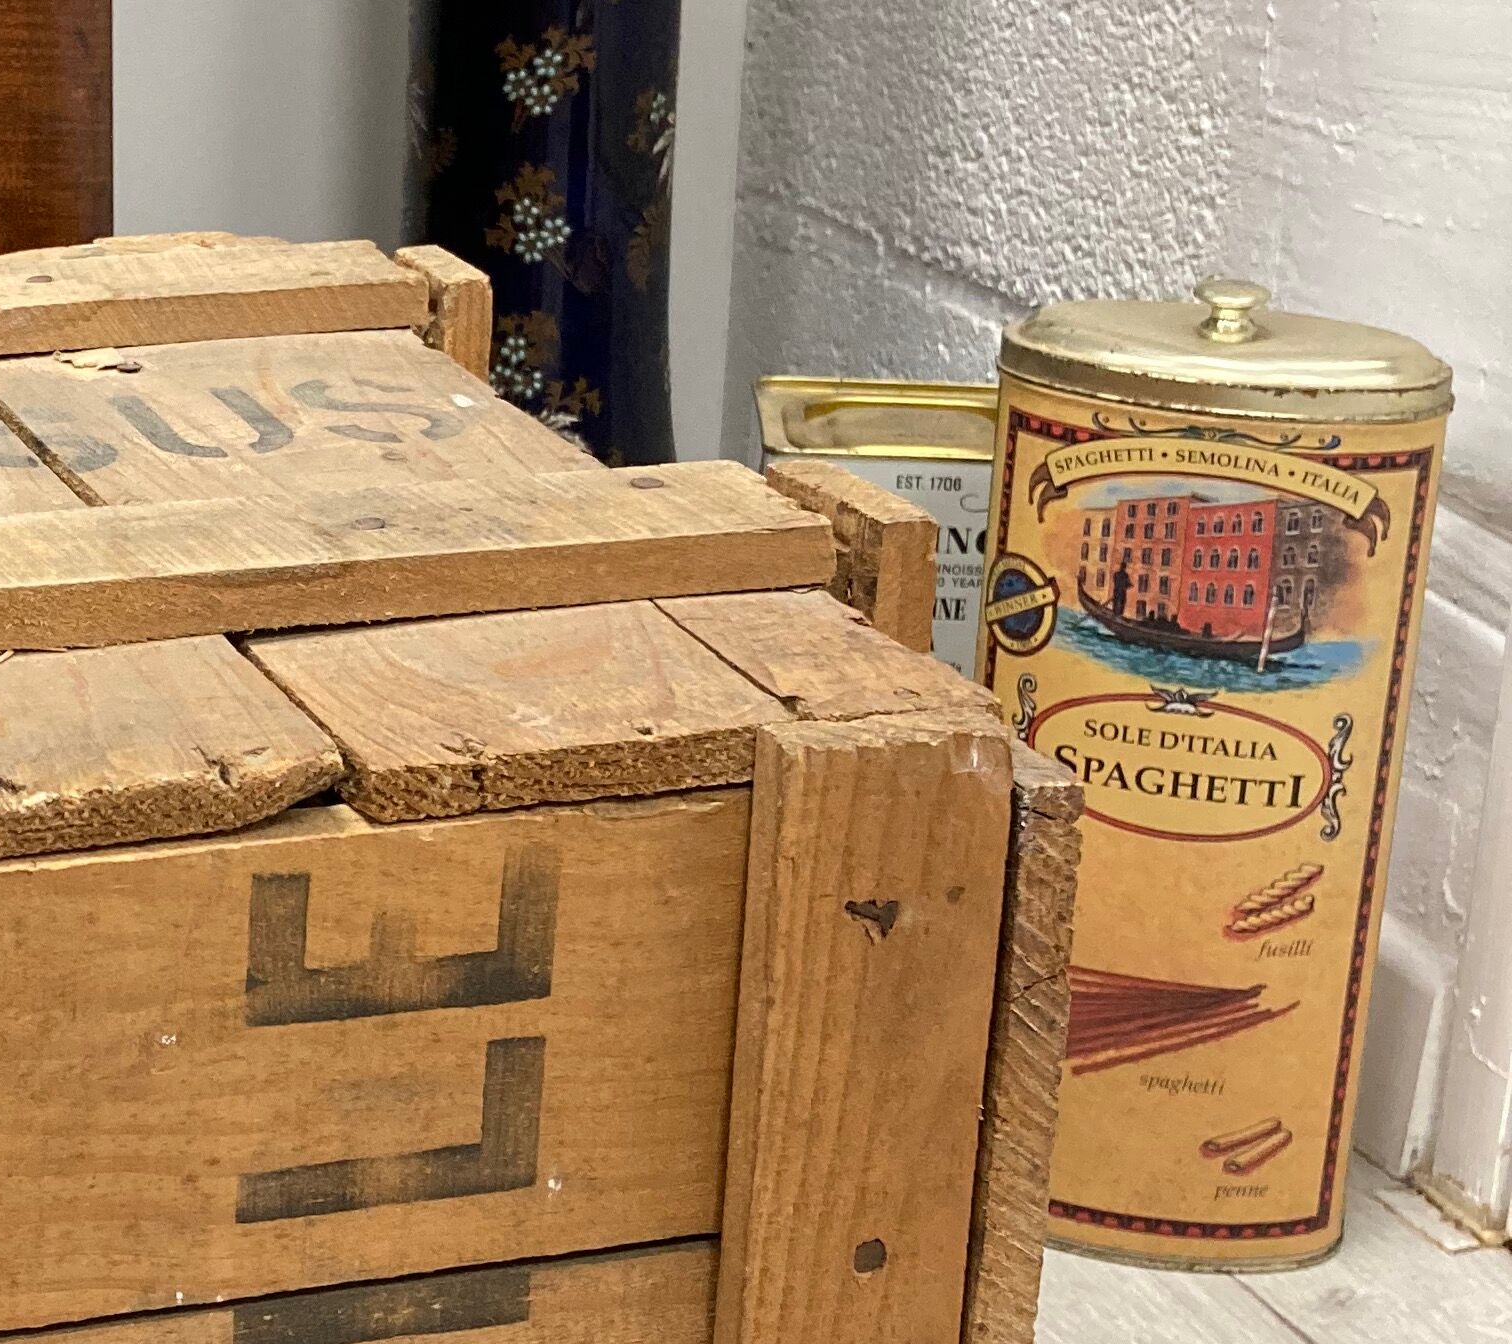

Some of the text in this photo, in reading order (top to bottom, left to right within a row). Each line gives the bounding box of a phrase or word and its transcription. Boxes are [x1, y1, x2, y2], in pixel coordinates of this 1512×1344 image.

[1054, 447, 1360, 505] SPAGHETTI SEMOLINA ITALIA
[1083, 718, 1278, 761] SOLE D'ITALIA
[1053, 743, 1306, 809] SPAGHETTI
[1255, 939, 1315, 962] fusilli
[1139, 1071, 1226, 1097] spaghetti
[1213, 1184, 1269, 1202] penne
